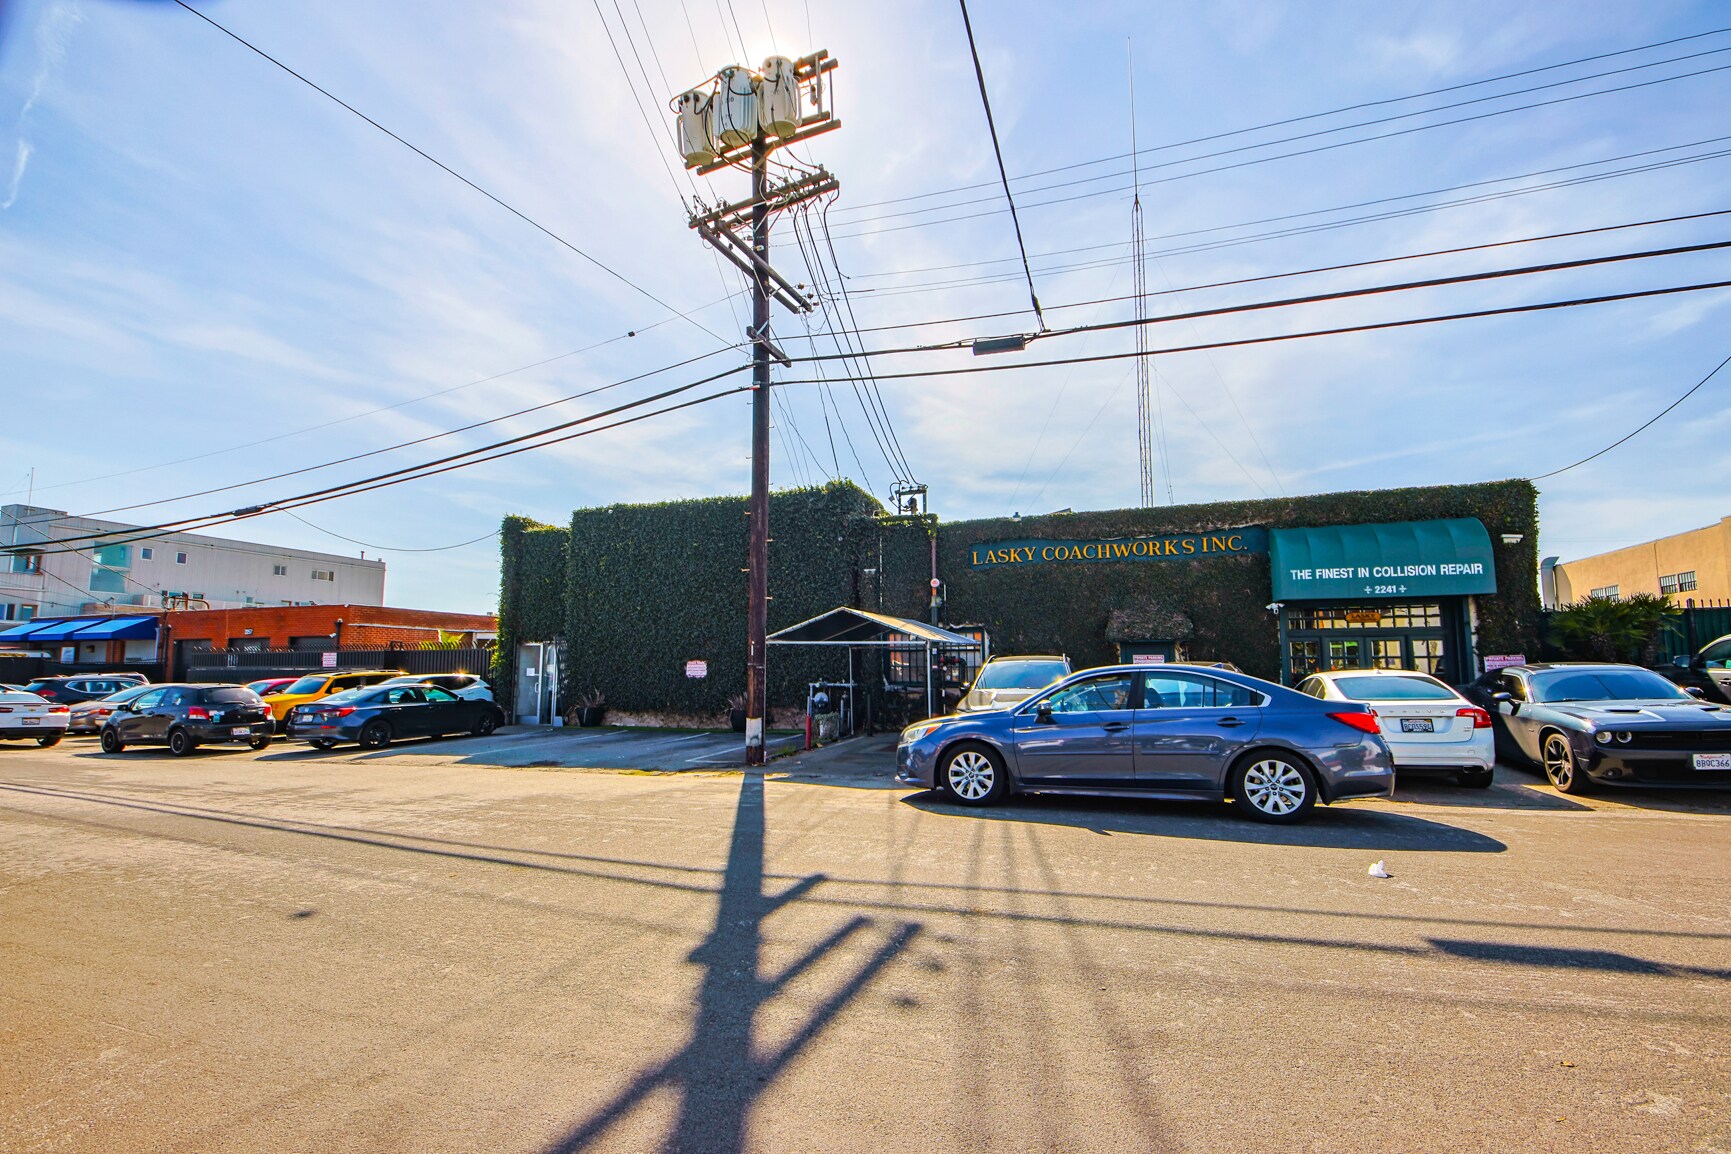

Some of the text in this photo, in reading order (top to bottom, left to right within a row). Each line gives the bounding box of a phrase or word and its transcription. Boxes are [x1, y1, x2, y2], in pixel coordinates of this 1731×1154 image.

[972, 535, 1248, 565] LASKY COACHWORKS INC.
[1290, 563, 1483, 580] THE FINEST IN COLLISION REPAIR
[1374, 585, 1397, 594] 2241
